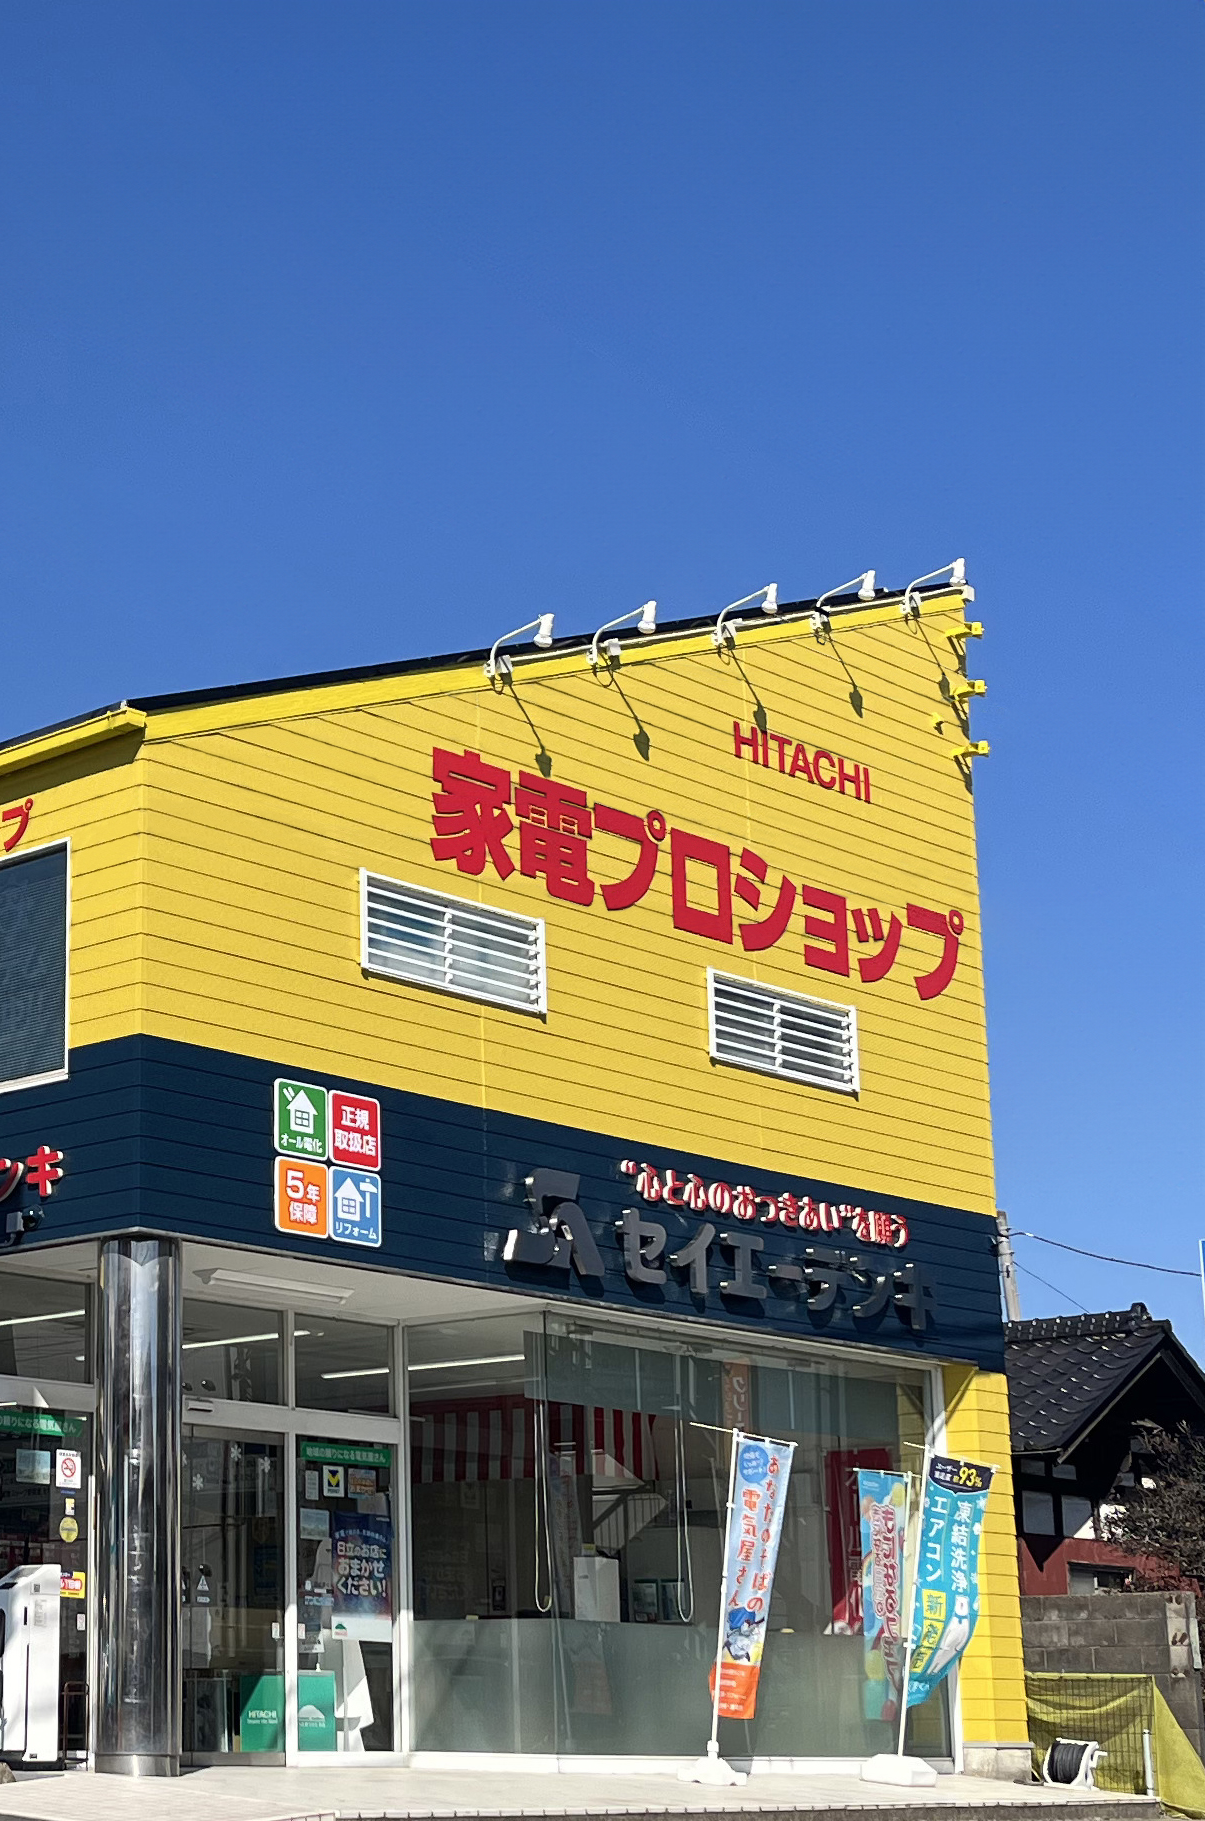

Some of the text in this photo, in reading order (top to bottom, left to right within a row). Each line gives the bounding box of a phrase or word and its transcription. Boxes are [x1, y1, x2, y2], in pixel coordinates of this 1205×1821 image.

[732, 720, 872, 804] HITACHI
[430, 746, 965, 1001] 家電プロショップ
[340, 1105, 370, 1131] 正規
[280, 1133, 323, 1154] オール電化
[334, 1129, 377, 1156] 取扱店
[285, 1168, 321, 1203] 5年
[335, 1221, 378, 1240] リフォーム
[614, 1207, 937, 1331] セイエーデンキ
[337, 1541, 387, 1559] 日立のお店に
[728, 1488, 762, 1608] 電気屋さん
[925, 1496, 948, 1582] エアコン
[950, 1500, 973, 1593] 凍結洗浄
[338, 1559, 385, 1578] おまかせ
[248, 1710, 277, 1718] HITACHI
